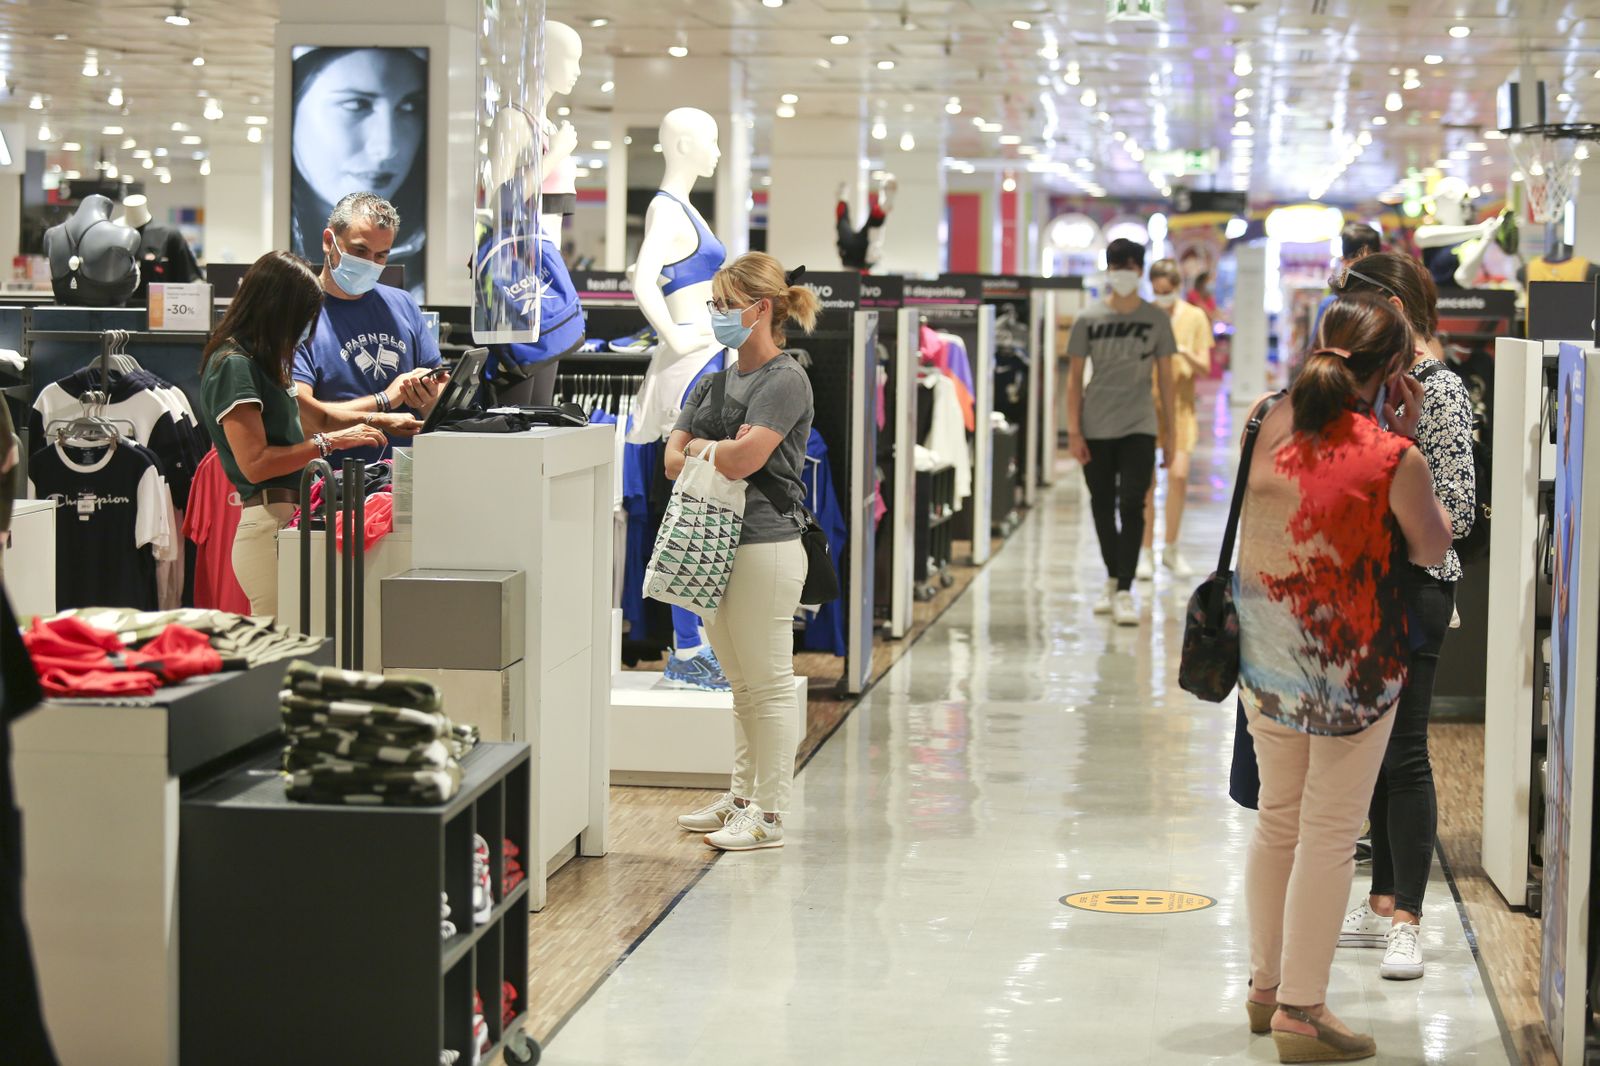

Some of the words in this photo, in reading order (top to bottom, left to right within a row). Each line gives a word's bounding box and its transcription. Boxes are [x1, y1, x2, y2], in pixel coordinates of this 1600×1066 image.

[167, 304, 195, 315] -30%
[340, 332, 407, 362] SPAGNOLO
[45, 493, 130, 510] Chpion
